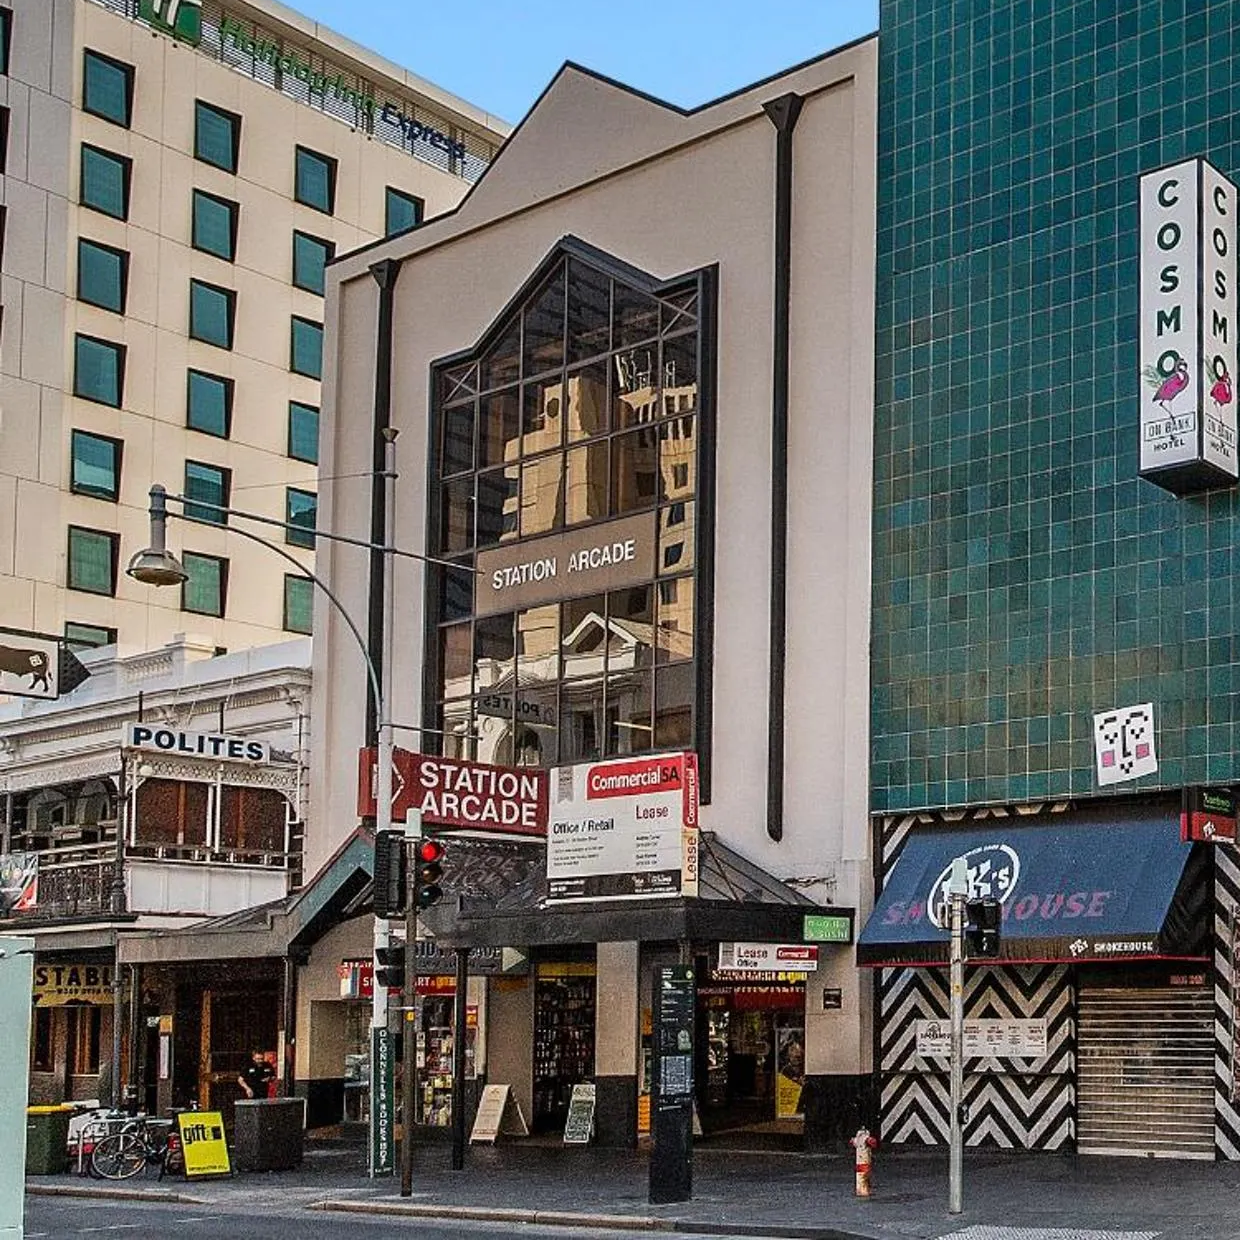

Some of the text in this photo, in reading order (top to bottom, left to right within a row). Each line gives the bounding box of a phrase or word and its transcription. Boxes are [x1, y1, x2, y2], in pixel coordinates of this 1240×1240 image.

[219, 16, 329, 94] Holiday
[381, 101, 466, 162] Express
[1157, 179, 1181, 378] COSMO
[1213, 186, 1228, 381] COSMO
[1148, 418, 1191, 437] ON BANK
[1153, 438, 1185, 452] HOTEL
[492, 539, 636, 590] STATION ARCADE
[133, 727, 264, 761] POLITES
[420, 761, 538, 800] STATION
[421, 791, 538, 827] ARCADE
[635, 805, 669, 820] Lease
[553, 822, 580, 835] Office
[588, 818, 614, 832] Retail
[684, 836, 697, 882] Lease
[737, 947, 768, 959] Lease
[737, 959, 758, 968] Office
[1094, 941, 1153, 953] SMOKEHOUSE
